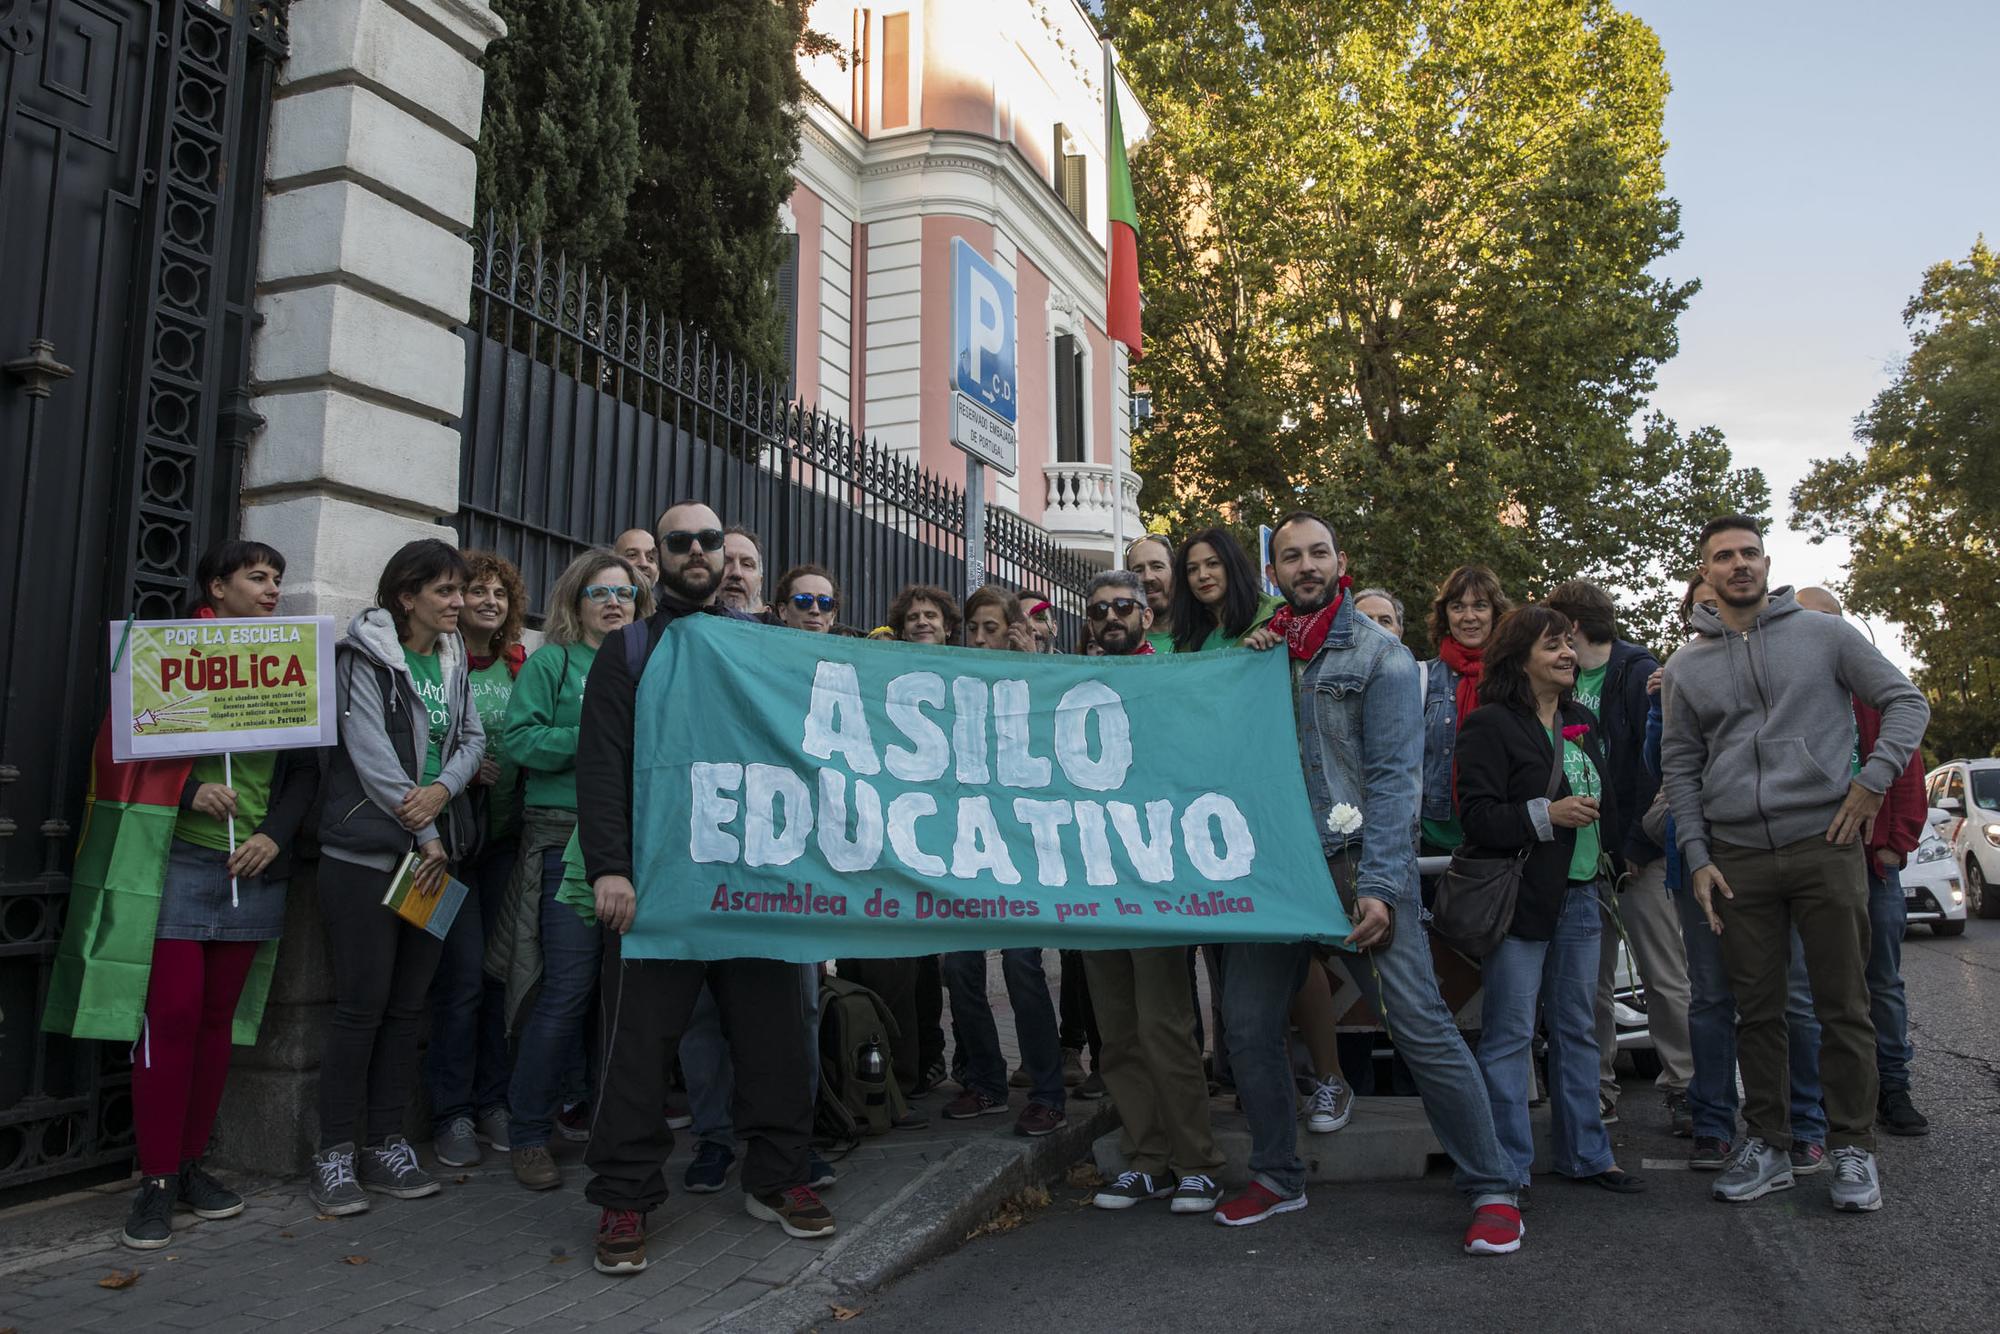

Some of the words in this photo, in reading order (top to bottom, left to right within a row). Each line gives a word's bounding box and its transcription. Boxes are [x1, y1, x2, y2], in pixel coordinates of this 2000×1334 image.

[970, 266, 1005, 384] P
[959, 401, 988, 431] RESERVADO
[989, 421, 1014, 445] EMBAJADA
[970, 428, 978, 444] DE
[979, 434, 1004, 459] PORTUGAL
[164, 628, 198, 646] POR
[202, 627, 225, 644] LA
[229, 625, 301, 645] ESCUELA
[277, 714, 306, 725] Portugal
[802, 659, 1133, 792] ASILO
[689, 761, 1256, 887] EDUCATIVO
[710, 882, 847, 916] Asamblea
[864, 887, 900, 918] de
[915, 889, 1040, 920] Docentes
[1055, 901, 1100, 923] por
[1114, 897, 1143, 915] la
